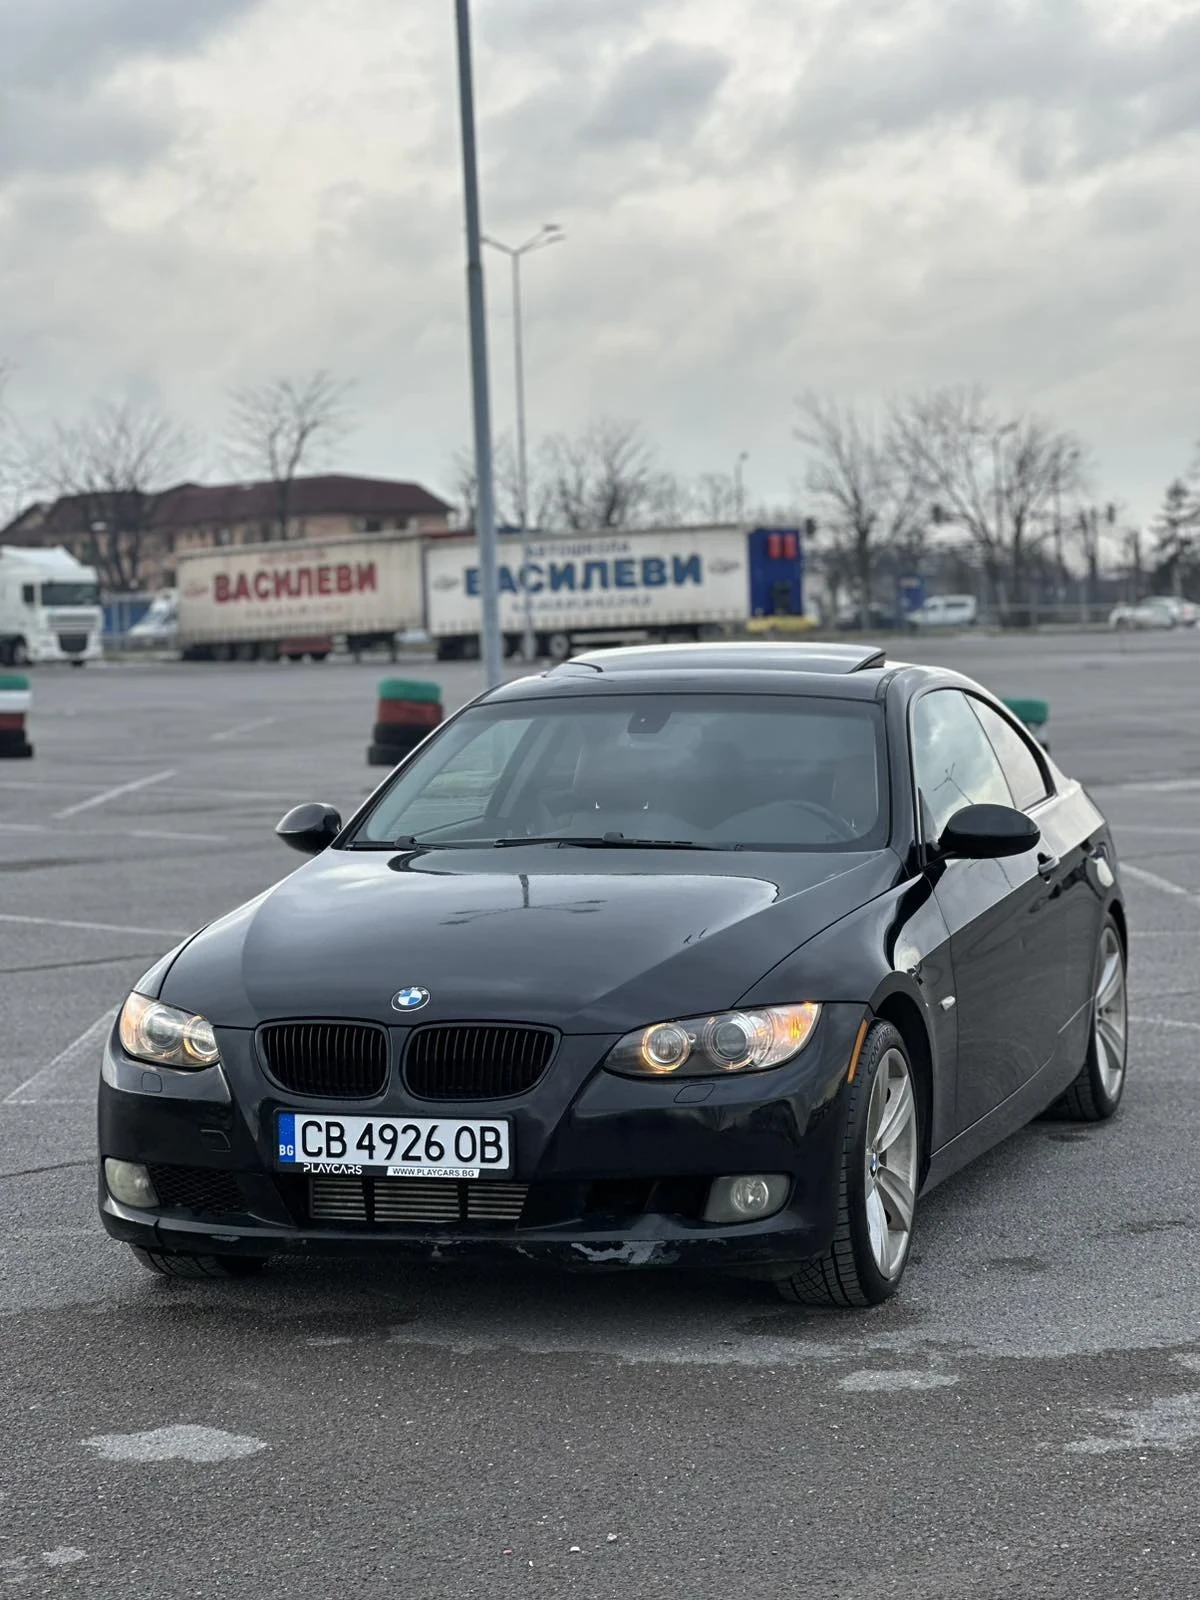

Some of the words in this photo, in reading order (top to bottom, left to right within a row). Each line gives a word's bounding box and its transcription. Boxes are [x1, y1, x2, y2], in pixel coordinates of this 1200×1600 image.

[213, 563, 377, 603] ВАСИЛЕВИ
[301, 1120, 347, 1158] CB
[356, 1122, 445, 1162] 4926
[454, 1126, 503, 1163] OB
[278, 1144, 294, 1156] BG
[303, 1162, 363, 1175] PLAYCARS
[392, 1168, 475, 1177] WWW.PLAYCARS.BG
